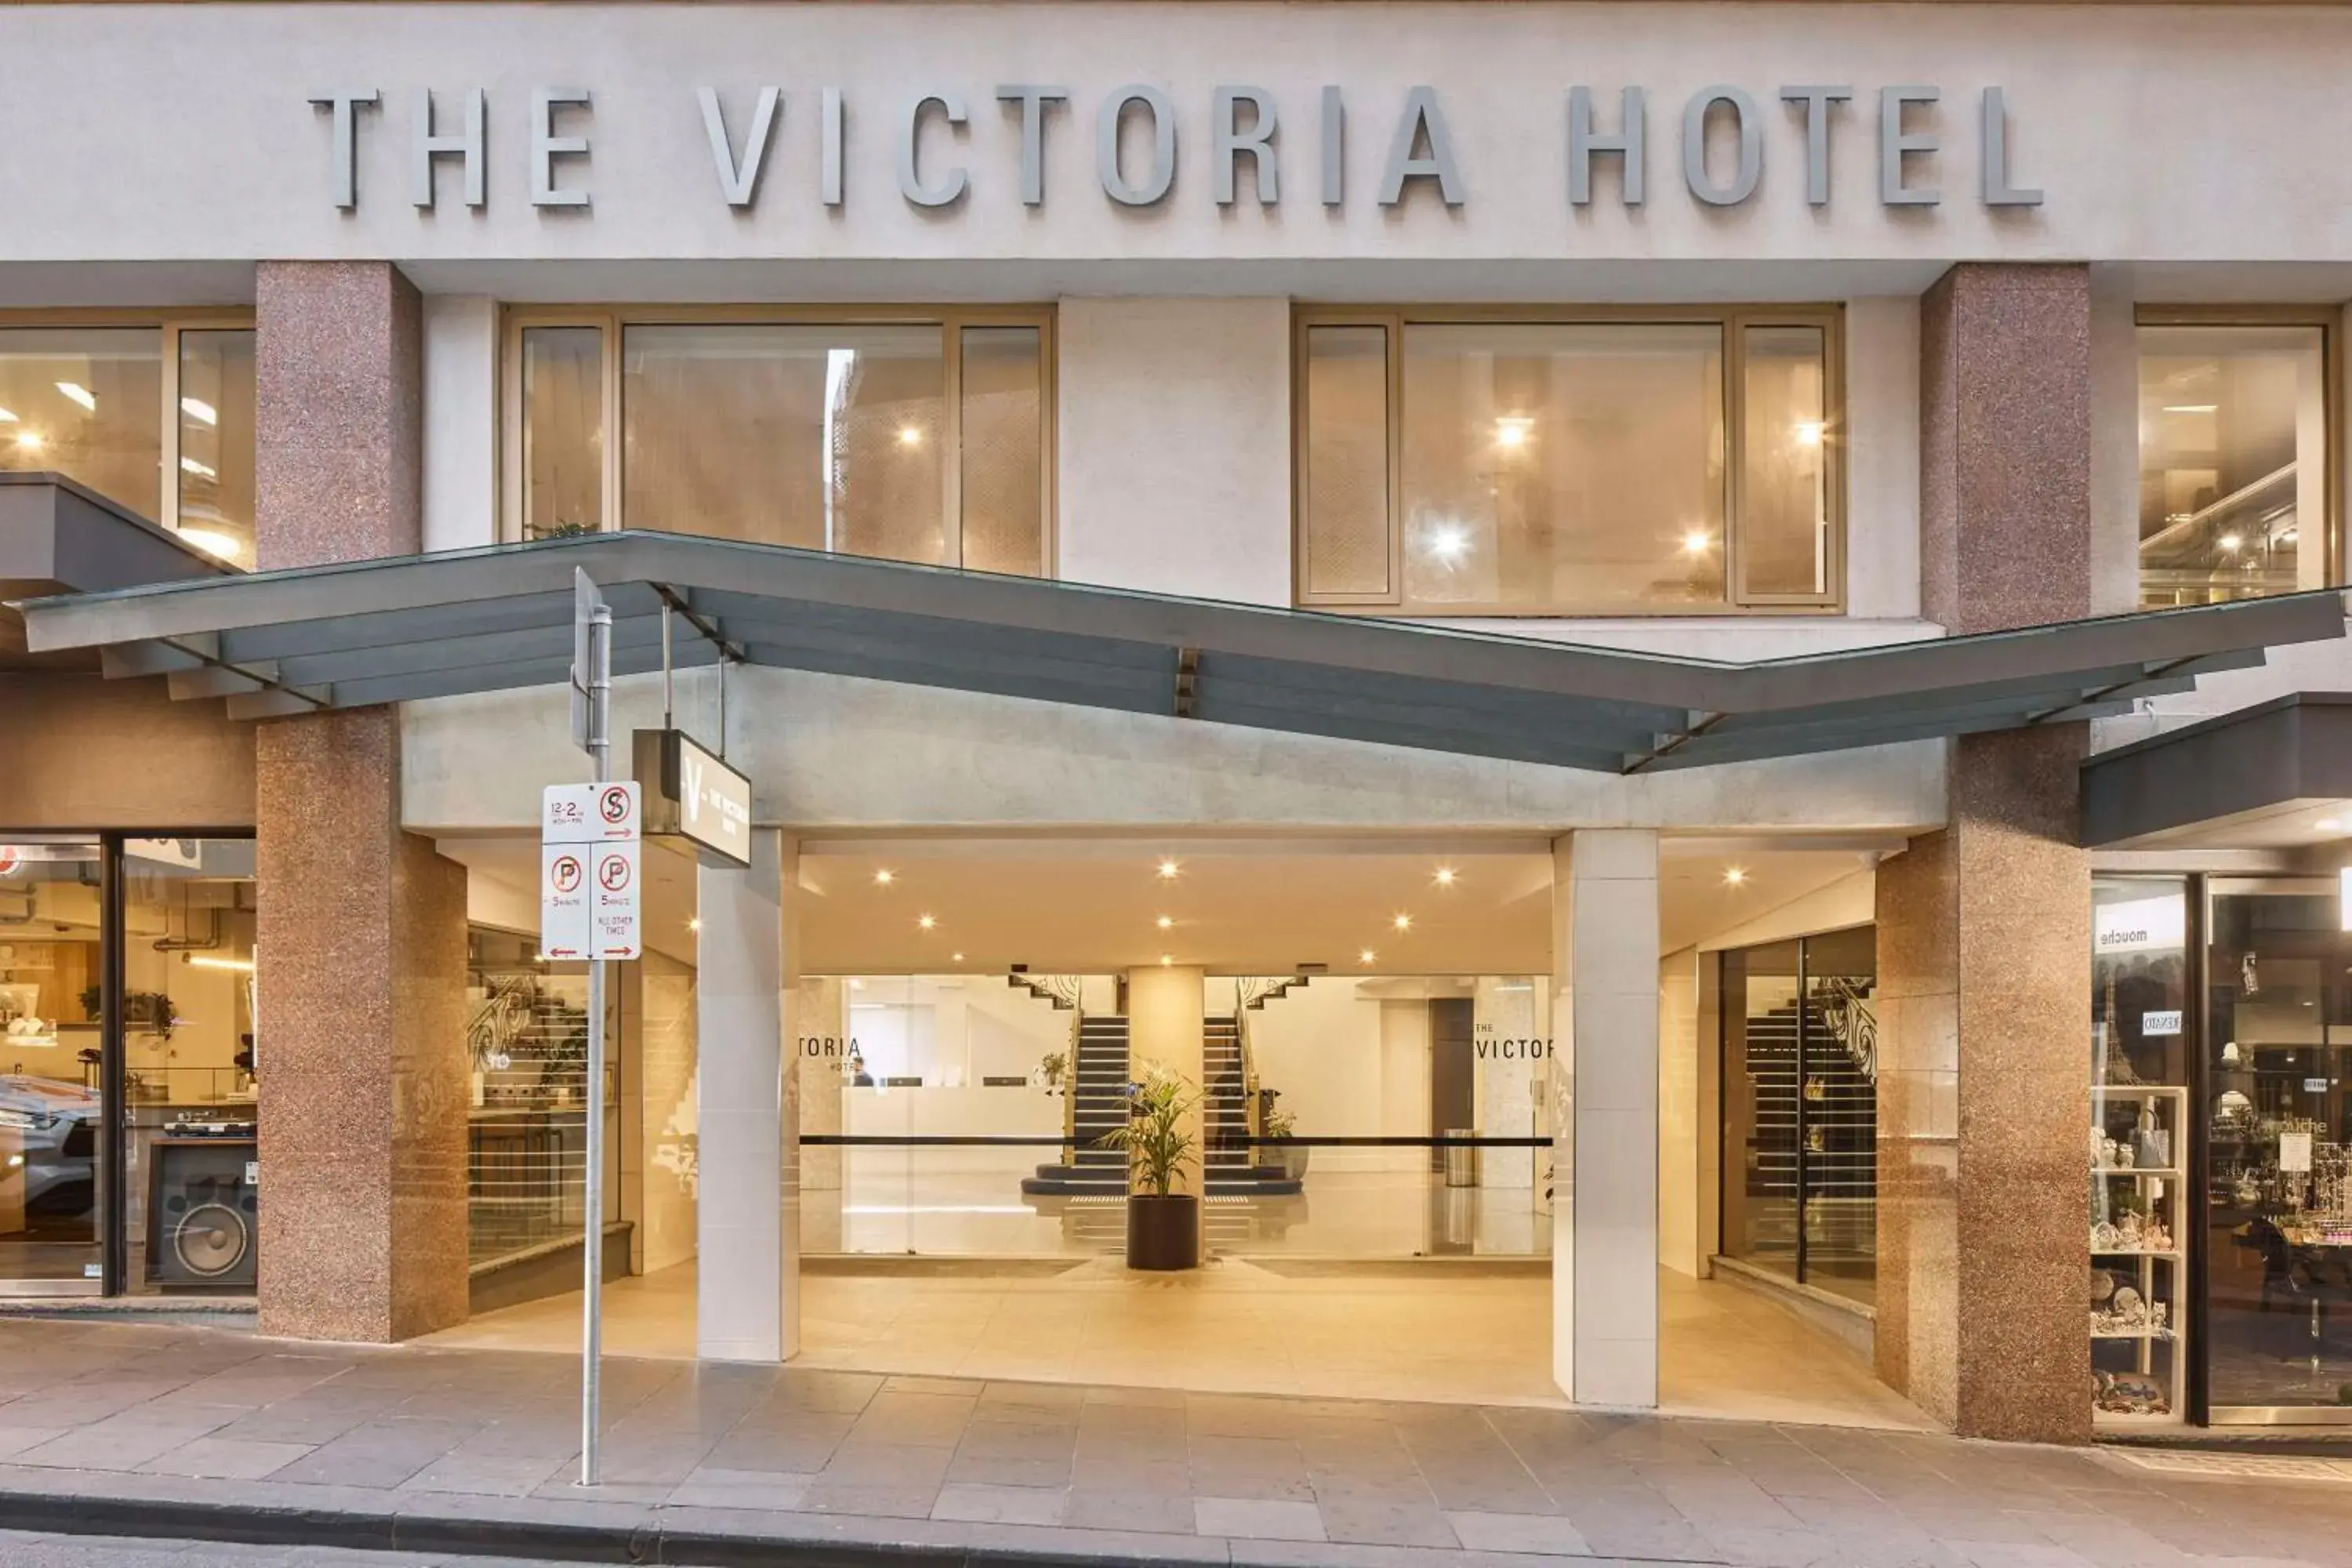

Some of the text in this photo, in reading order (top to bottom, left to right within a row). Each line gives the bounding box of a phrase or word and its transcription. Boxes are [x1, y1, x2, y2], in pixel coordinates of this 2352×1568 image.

[307, 85, 2045, 209] THE VICTORIA HOTEL
[561, 863, 575, 884] P
[610, 862, 623, 883] P
[1475, 1023, 1493, 1033] THE
